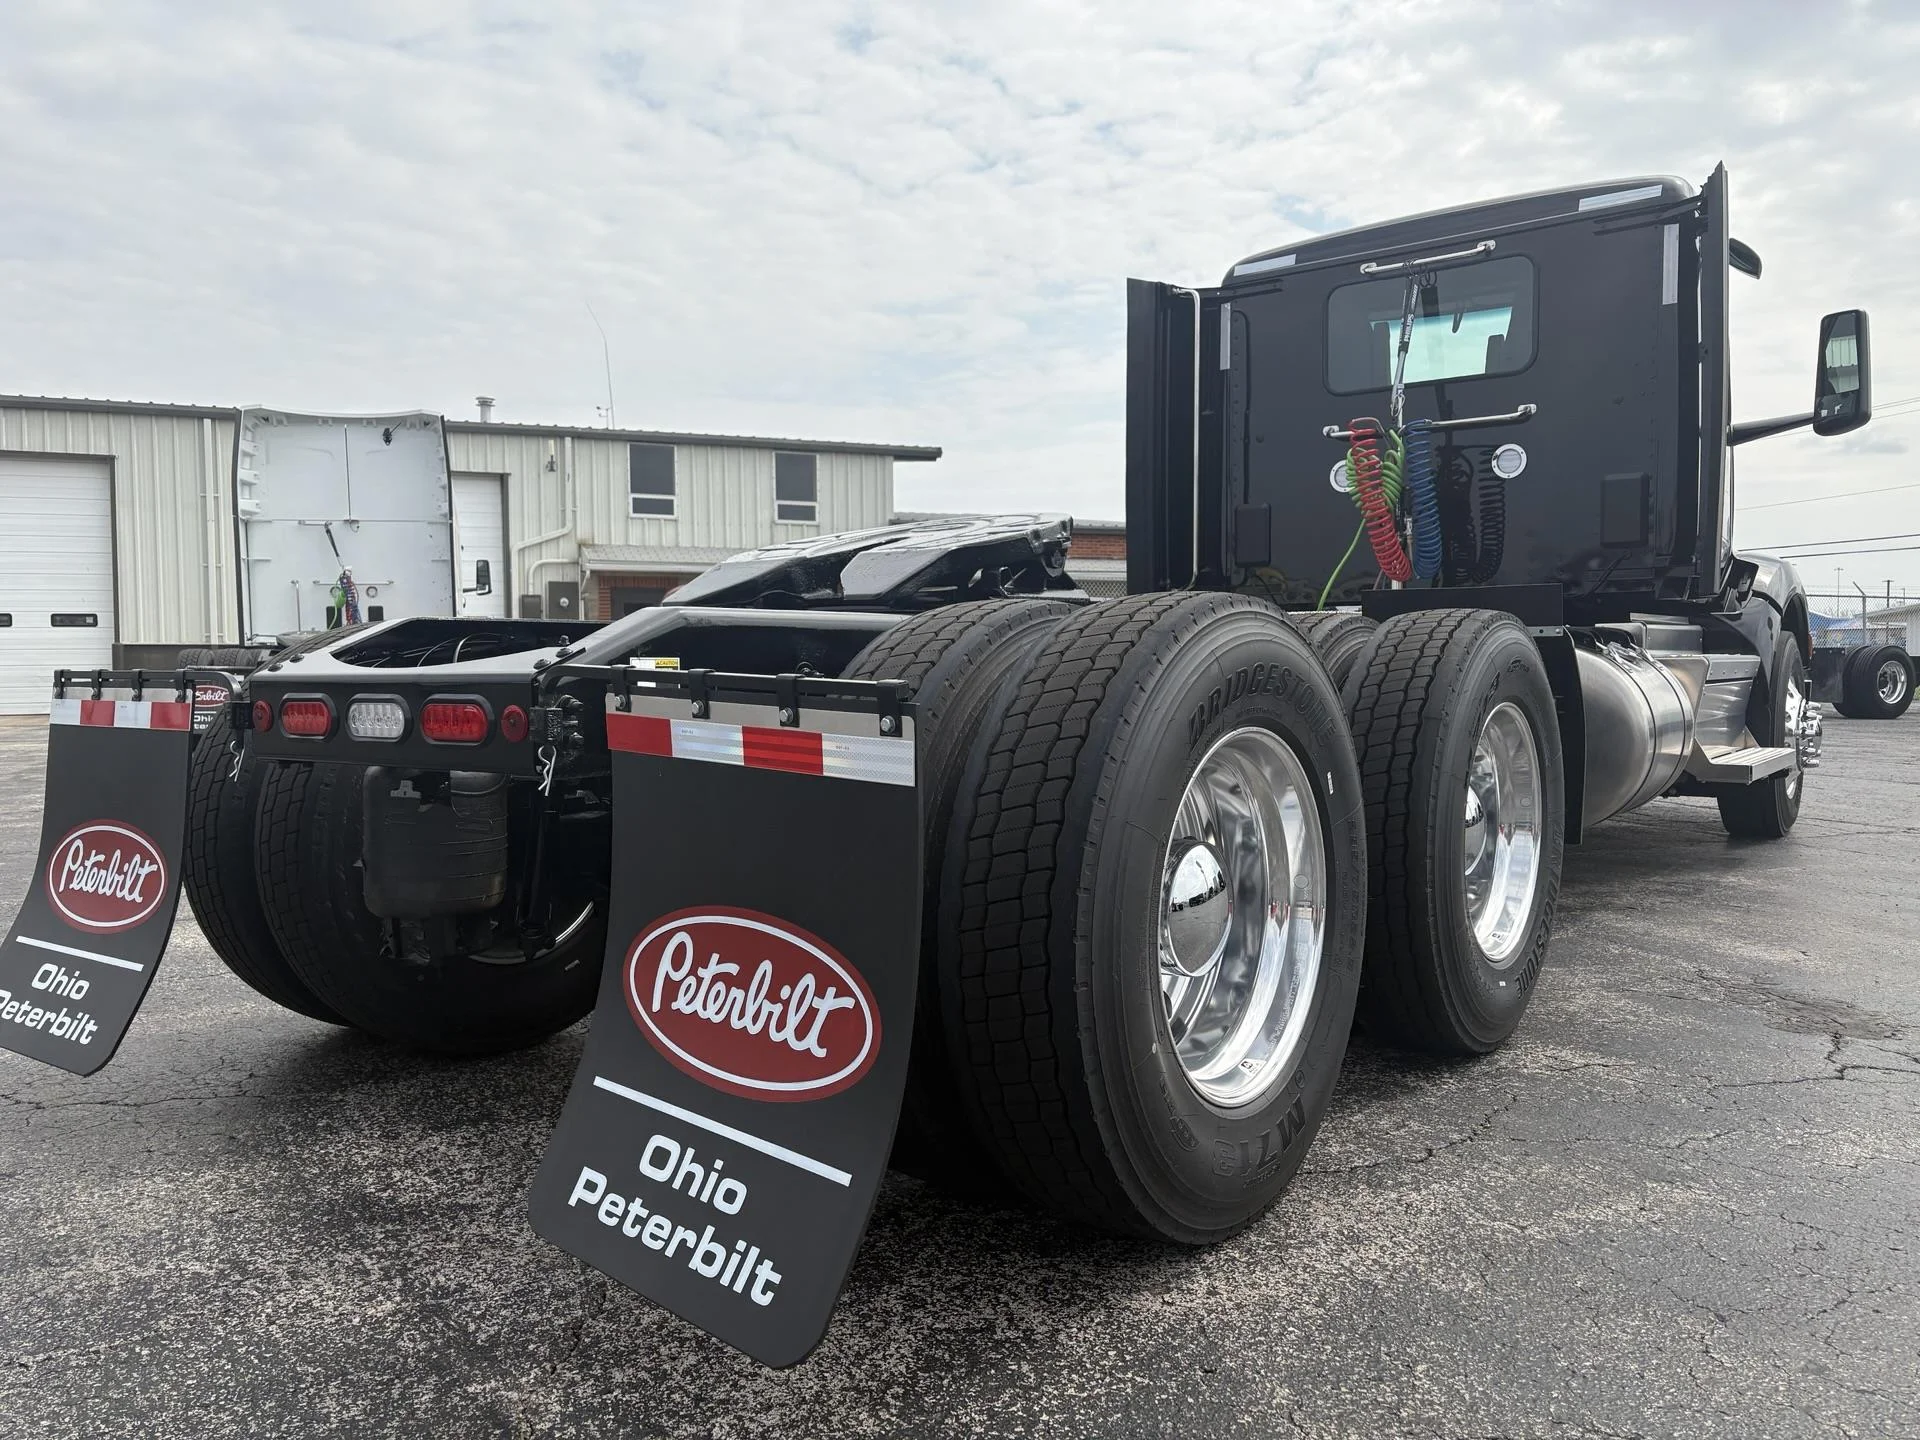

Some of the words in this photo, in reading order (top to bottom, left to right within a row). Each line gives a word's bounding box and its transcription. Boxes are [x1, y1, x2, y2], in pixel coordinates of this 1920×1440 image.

[194, 714, 213, 722] Ohi
[1189, 661, 1337, 752] BRIDGESTONE
[59, 838, 158, 903] Peterbilt
[31, 962, 90, 1001] Ohio
[652, 931, 856, 1058] Peterbilt
[639, 1133, 748, 1215] Ohio
[567, 1166, 783, 1306] Peterbilt
